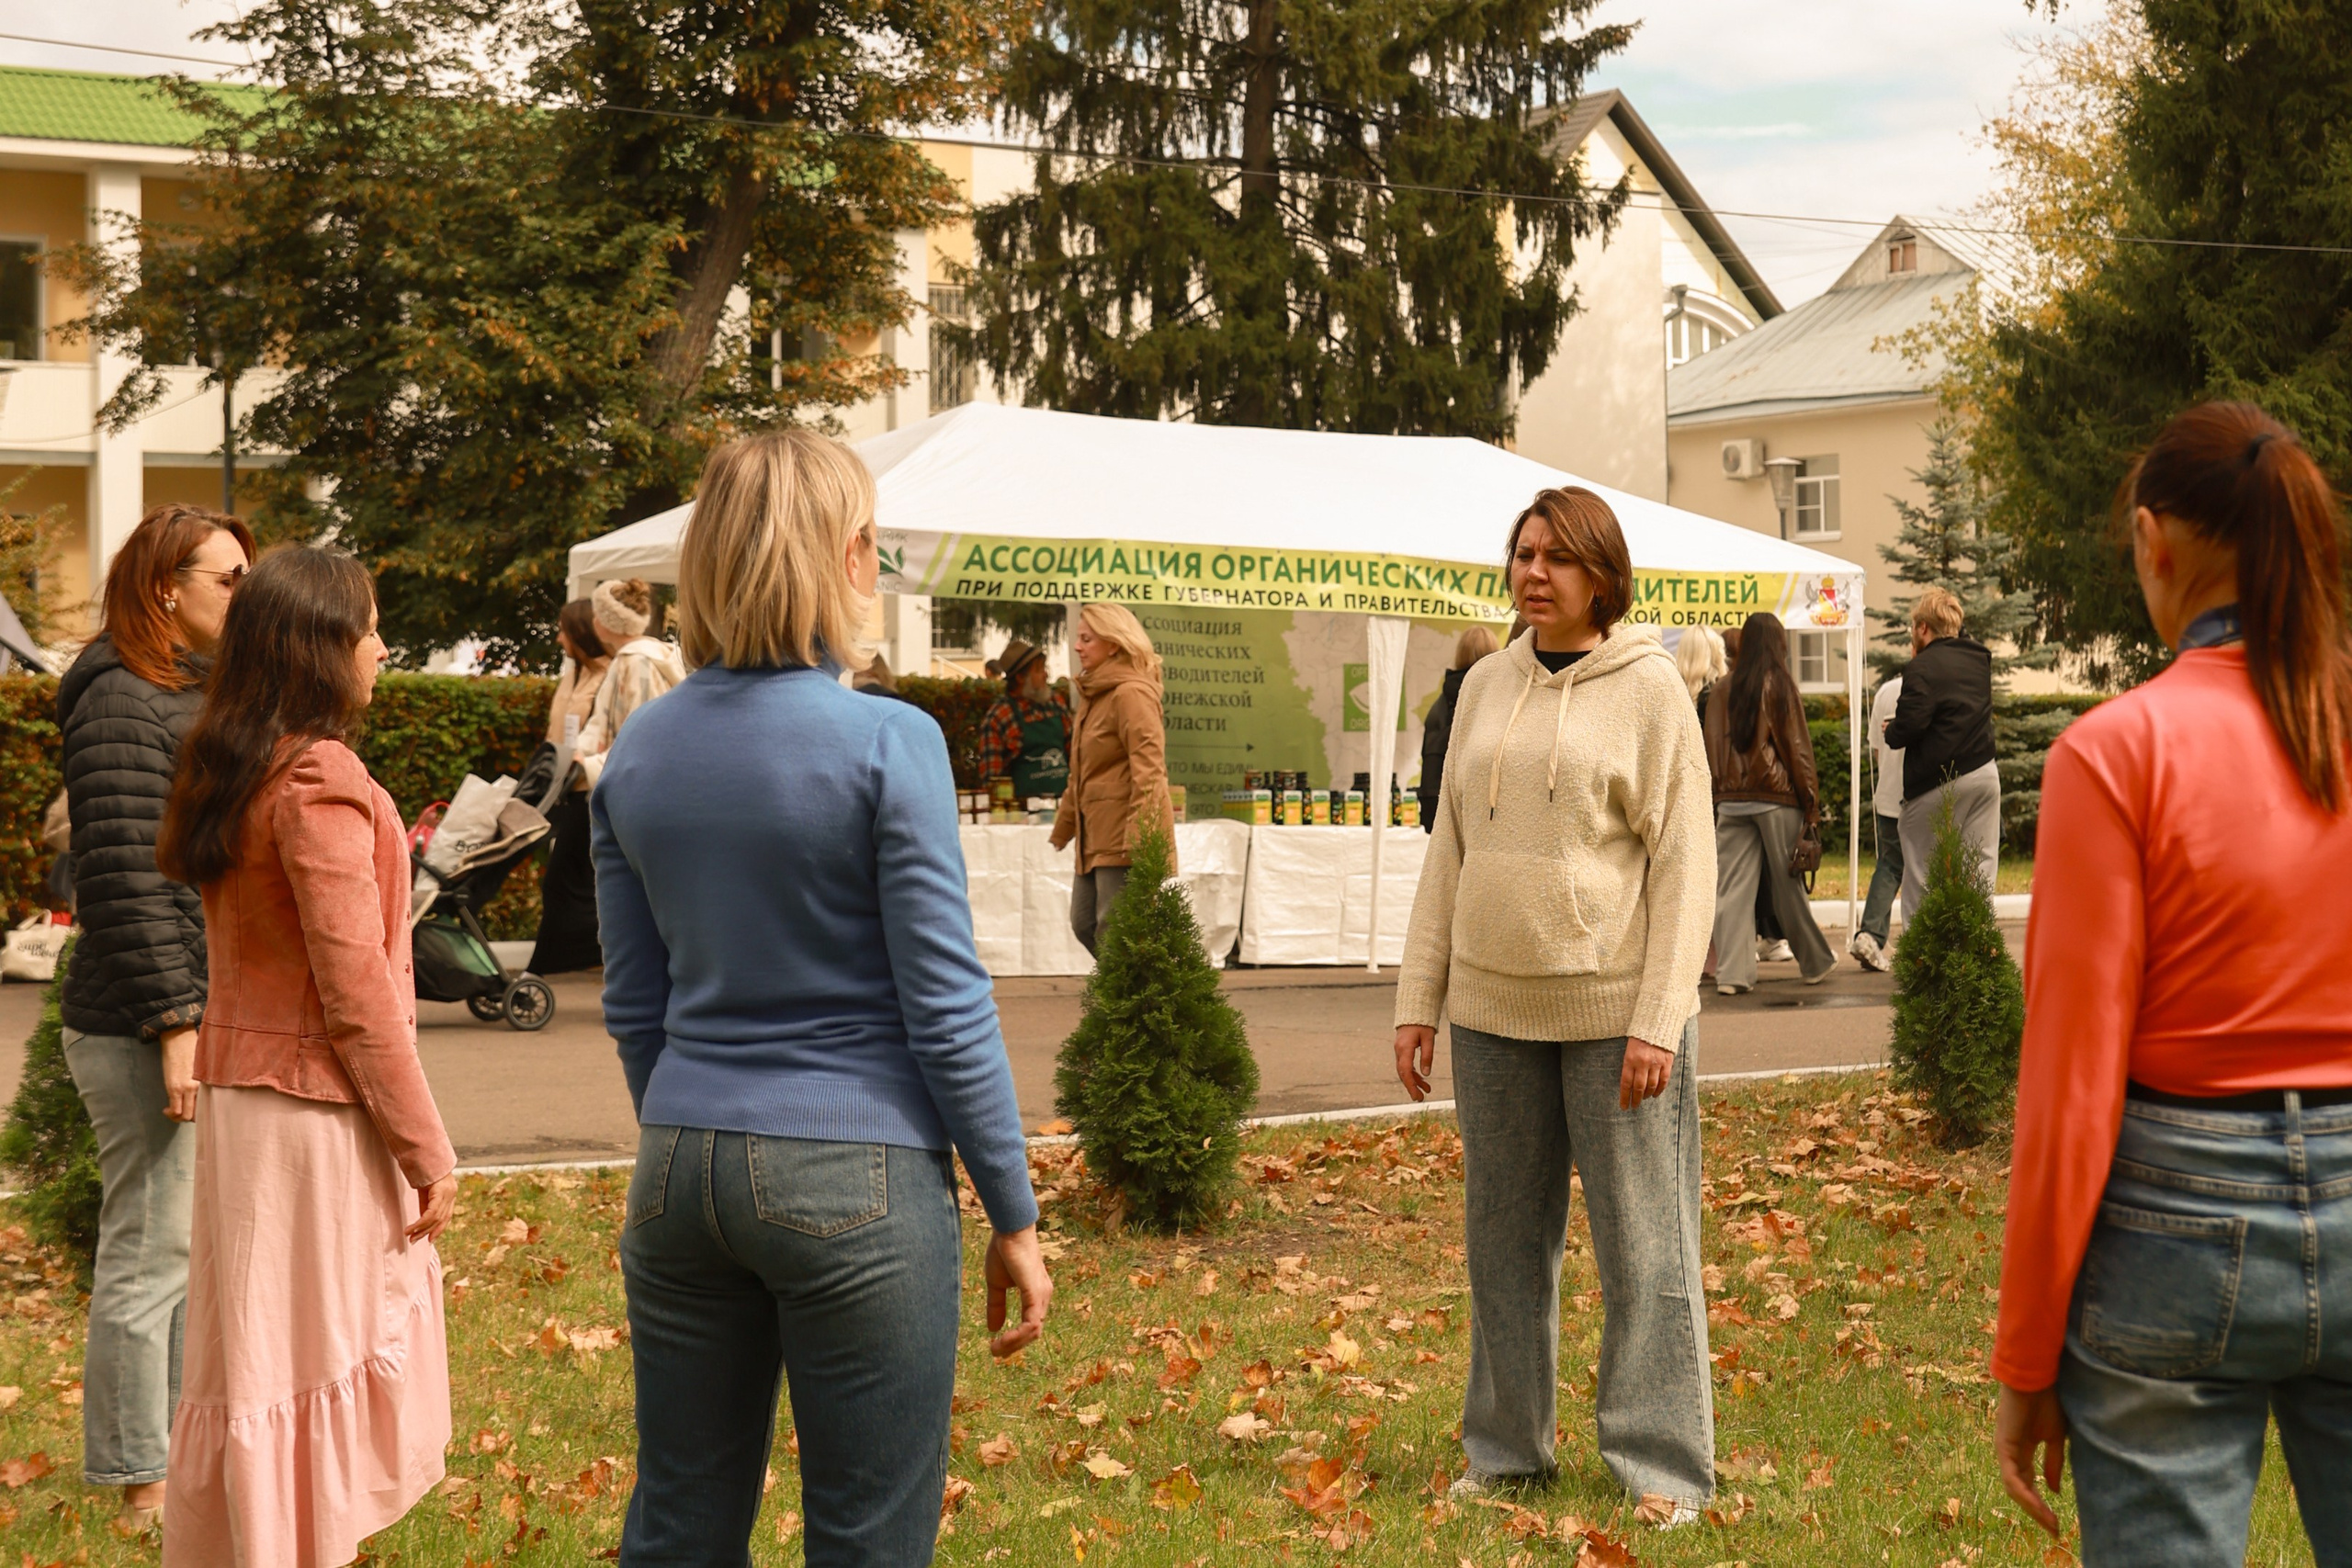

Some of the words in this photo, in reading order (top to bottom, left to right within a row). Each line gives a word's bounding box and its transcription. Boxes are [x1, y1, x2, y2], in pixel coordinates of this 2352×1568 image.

[963, 544, 1201, 580] АССОЦИАЦИЯ
[1212, 554, 1470, 595] ОРГАНИЧЕСКИХ
[956, 580, 1003, 597] ПРИ
[1012, 581, 1152, 601] ПОДДЕРЖКЕ
[1164, 586, 1308, 607] ГУБЕРНАТОРА
[1319, 592, 1333, 608] И
[1344, 593, 1506, 619] ПРАВИТЕЛЬСТВА
[1671, 610, 1749, 626] ОБЛАСТ
[1131, 610, 1243, 638] ссоциация
[1153, 641, 1251, 660] анических
[1163, 710, 1227, 732] бласти
